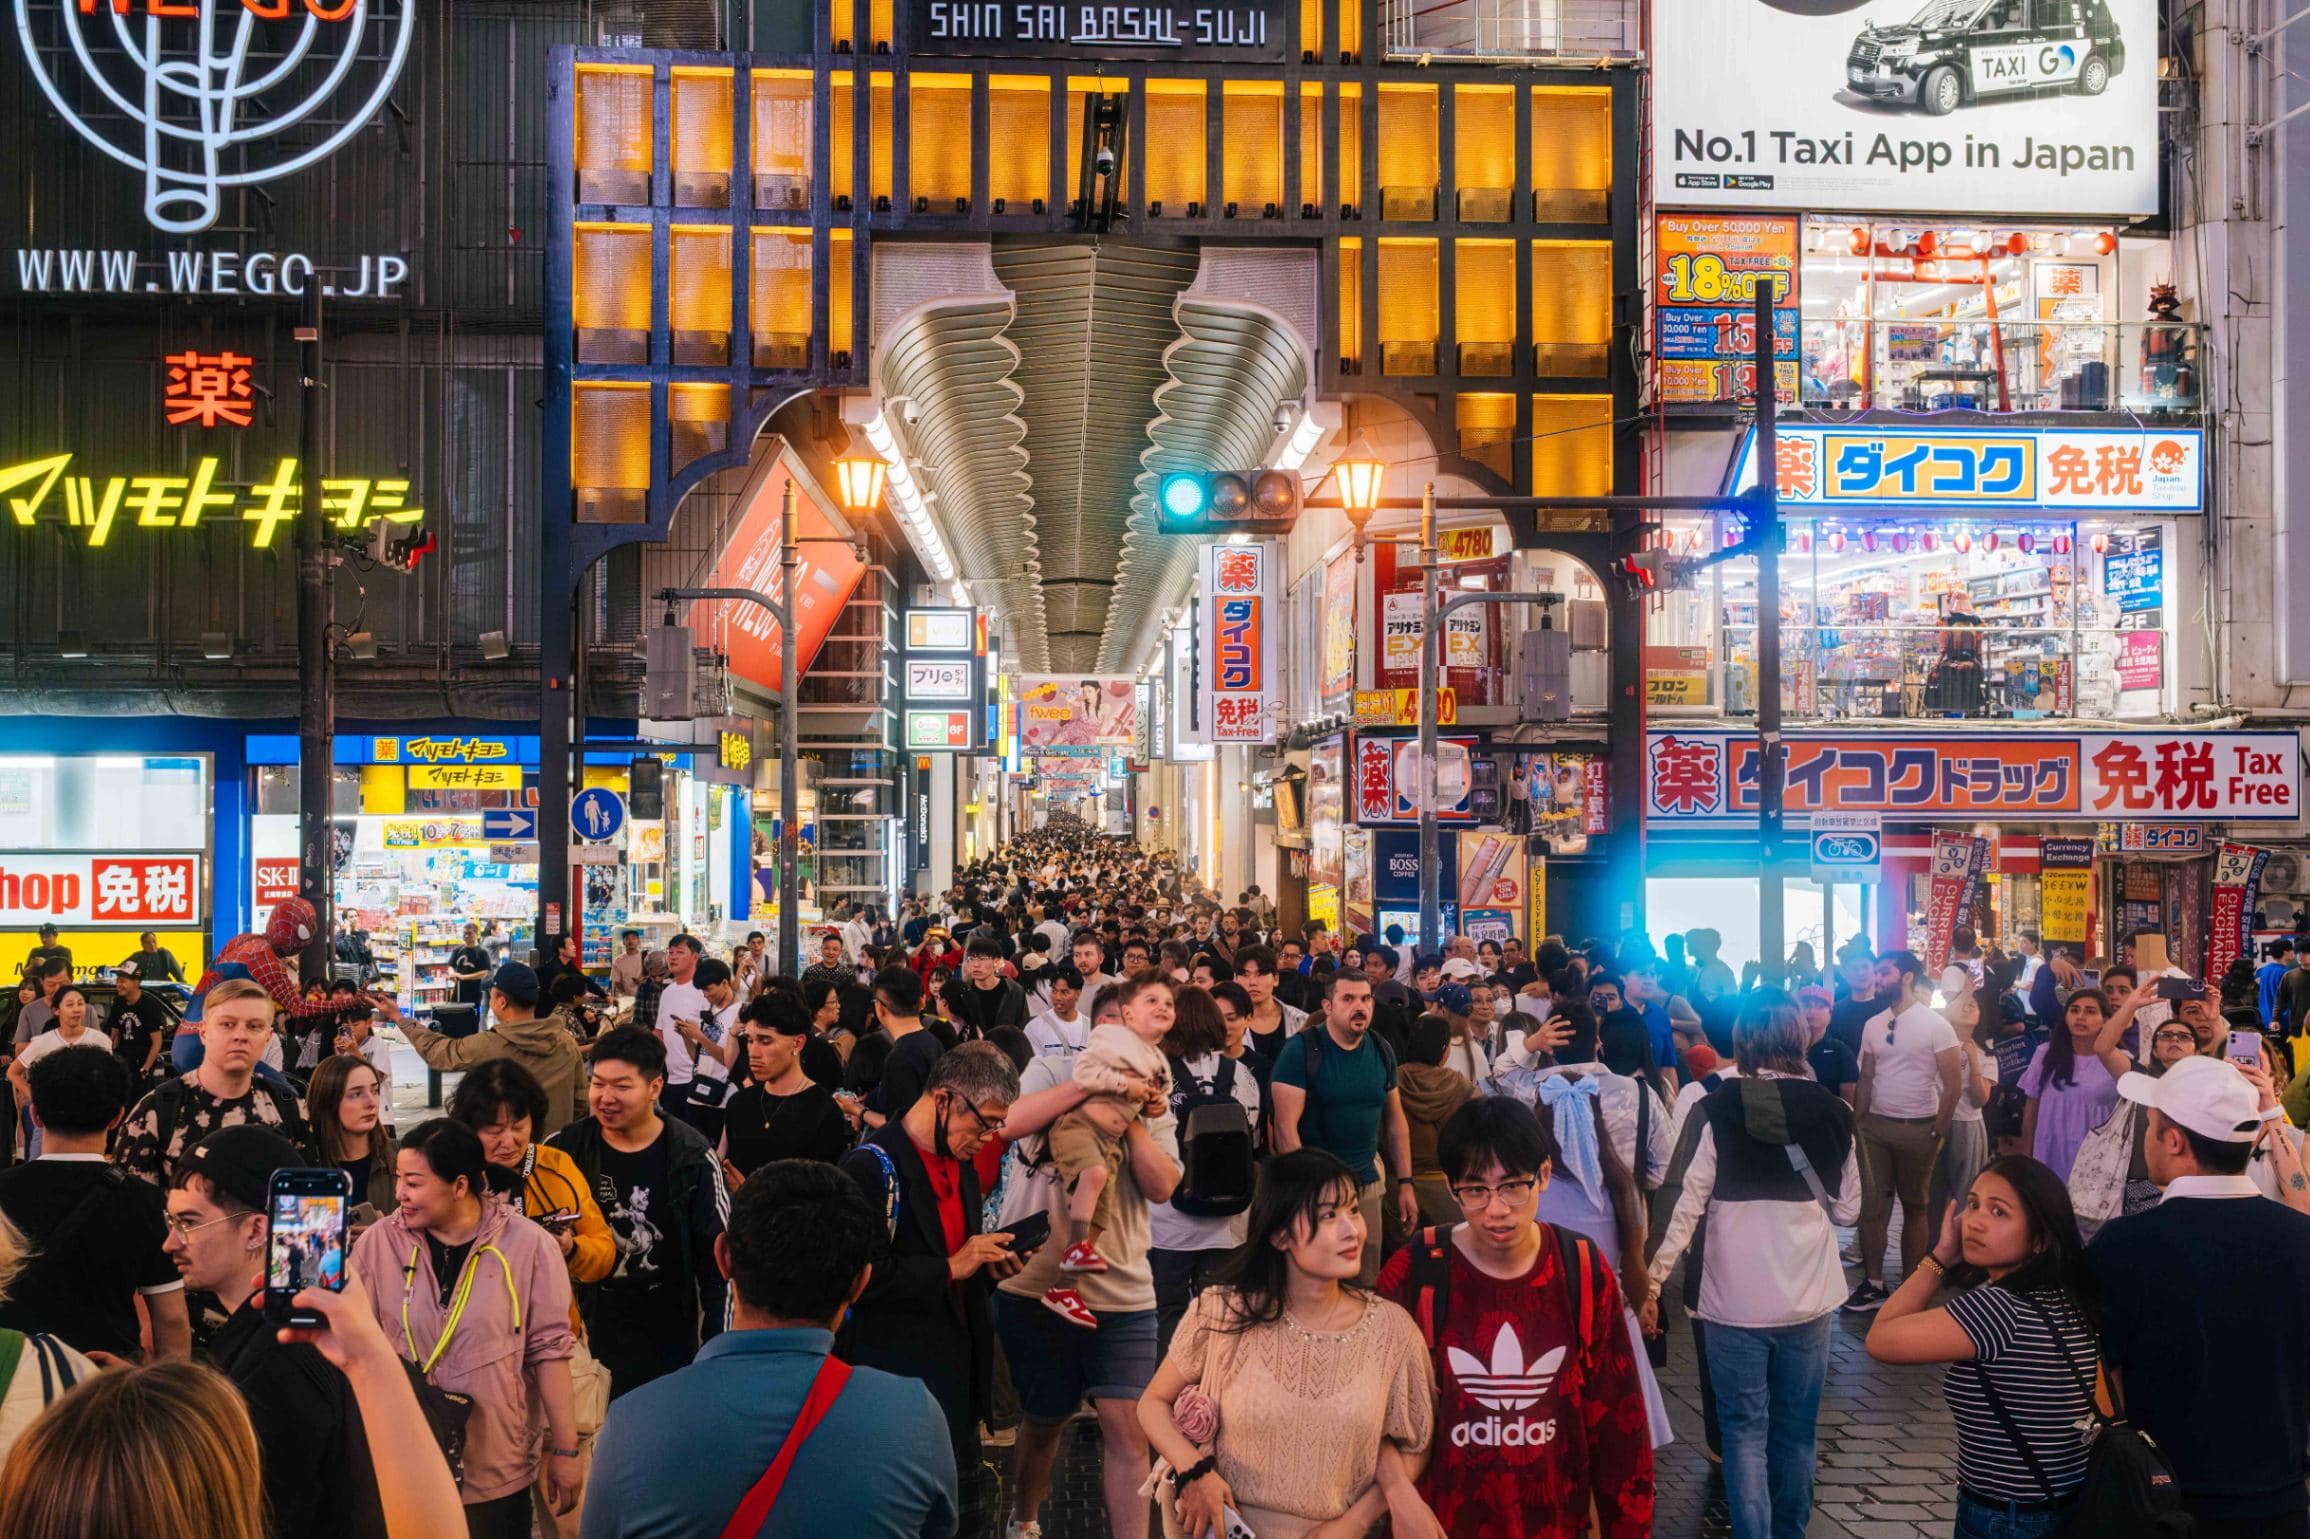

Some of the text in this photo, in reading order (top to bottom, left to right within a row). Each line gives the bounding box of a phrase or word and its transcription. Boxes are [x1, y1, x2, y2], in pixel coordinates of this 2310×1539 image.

[931, 3, 1001, 37] SHIN
[1017, 5, 1065, 39] SAI
[1981, 56, 2026, 79] TAXI
[1674, 129, 2135, 176] No.1 Taxi App in Japan
[1667, 221, 1785, 233] Buy Over 50,000 Yen
[18, 248, 409, 298] WWW.WEGO.JP
[1671, 257, 1787, 300] 18%OF
[1666, 313, 1702, 323] Buy Over
[1692, 324, 1707, 333] Yen
[1666, 365, 1703, 375] Buy Over
[1692, 377, 1707, 386] Yen
[165, 351, 255, 428] 薬
[1836, 441, 2024, 494] ダイコク
[2047, 444, 2144, 498] 免税
[0, 452, 424, 547] マツモトキヨシ
[2120, 535, 2148, 553] 3F
[1219, 549, 1257, 590] 薬
[1387, 622, 1424, 635] アリナミ
[1449, 619, 1481, 633] アリナミン
[2121, 614, 2148, 630] 2F
[1223, 600, 1253, 688] ダイコク
[1387, 634, 1424, 656] EX
[1449, 634, 1481, 653] EX
[1029, 704, 1072, 720] fwee
[1216, 697, 1259, 726] 免税
[949, 724, 964, 735] 6F
[1216, 726, 1260, 737] Tax-Free
[406, 738, 506, 761] マツモトキヨシ
[2233, 746, 2283, 775] Tax
[428, 767, 505, 787] マツモトキヨシ
[1362, 741, 1390, 814] 薬
[1651, 737, 1719, 812] 薬
[2092, 740, 2218, 812] 免税
[2229, 776, 2290, 807] Free
[2046, 843, 2088, 853] Currency
[2146, 829, 2198, 847] ダイコク
[1389, 857, 1419, 871] BOSS
[2046, 853, 2090, 862] Exchange
[97, 864, 187, 914] 免税
[1927, 883, 1946, 968] EXCHANG
[1933, 884, 1958, 974] CURRENCY
[2224, 893, 2238, 974] CURRENC
[1450, 1415, 1556, 1447] adidas
